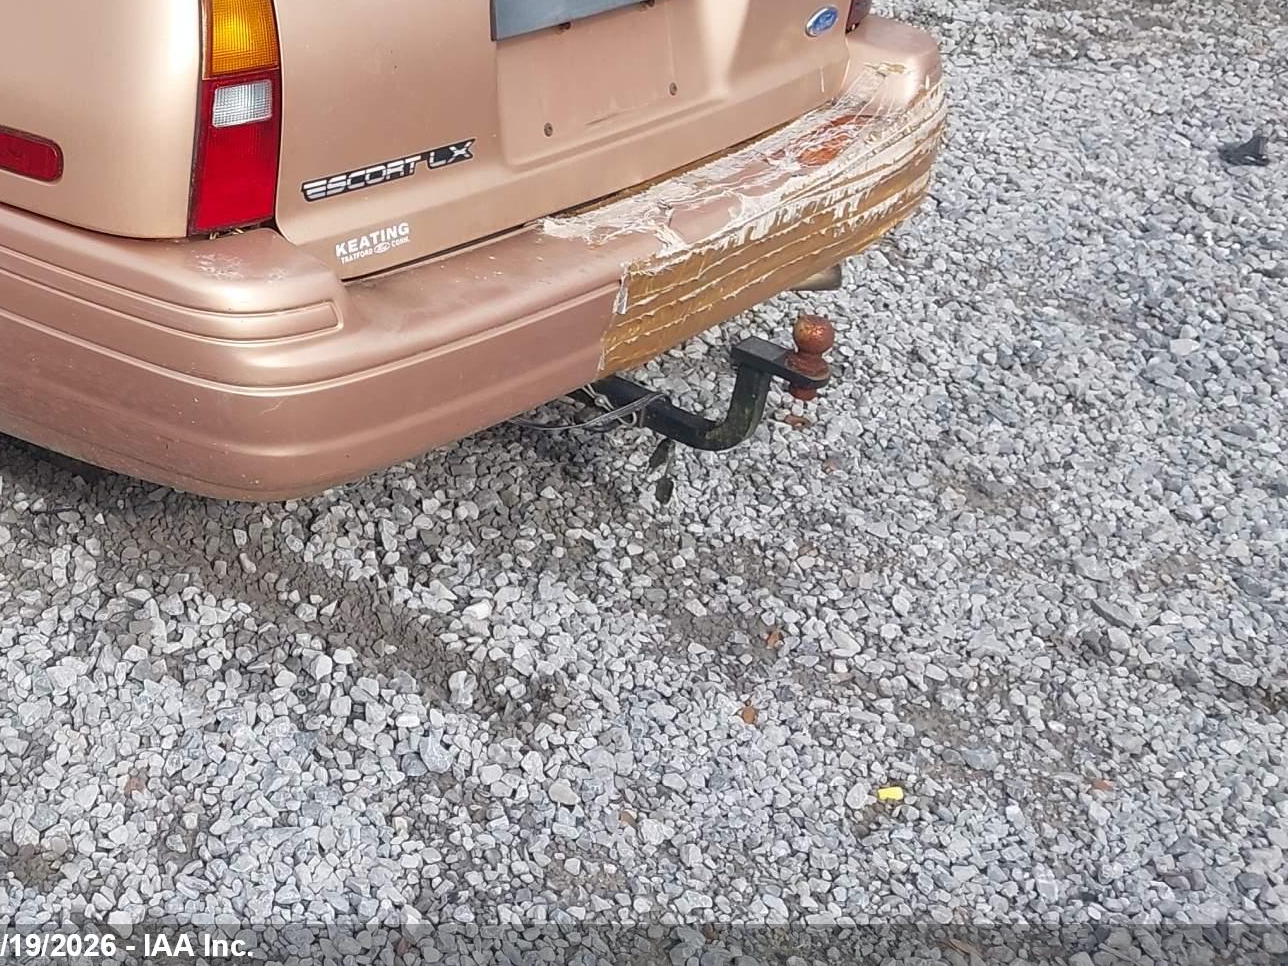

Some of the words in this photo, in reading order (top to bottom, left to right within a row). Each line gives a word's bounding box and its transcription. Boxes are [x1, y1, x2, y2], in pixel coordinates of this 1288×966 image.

[302, 155, 422, 202] ESCORT
[428, 140, 475, 169] LX
[335, 222, 410, 257] KEATING
